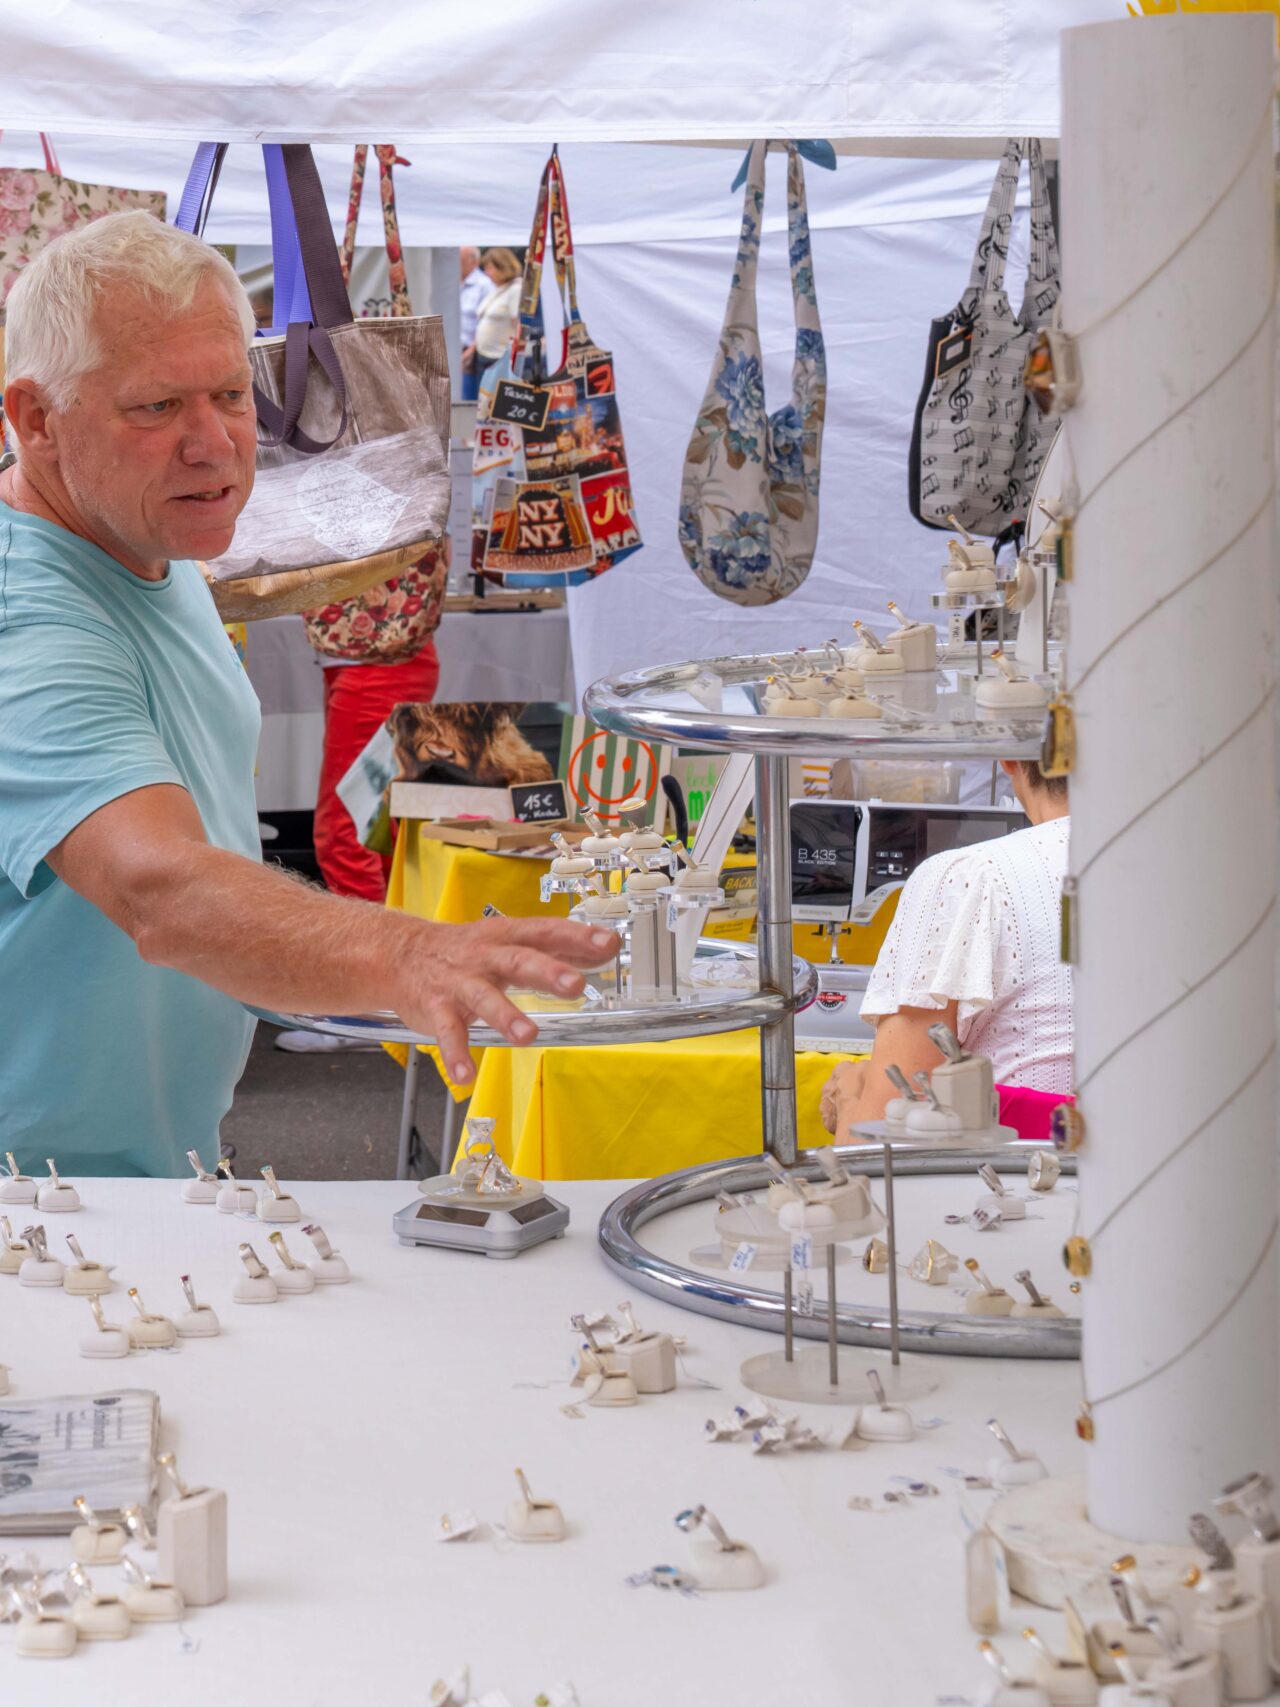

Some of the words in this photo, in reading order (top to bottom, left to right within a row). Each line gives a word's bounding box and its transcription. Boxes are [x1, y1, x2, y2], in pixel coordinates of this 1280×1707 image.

[507, 404, 527, 418] 20
[519, 499, 560, 521] NY
[520, 522, 565, 547] NY
[524, 793, 541, 810] 15
[542, 793, 553, 806] €
[798, 848, 808, 859] B
[811, 849, 837, 861] 435
